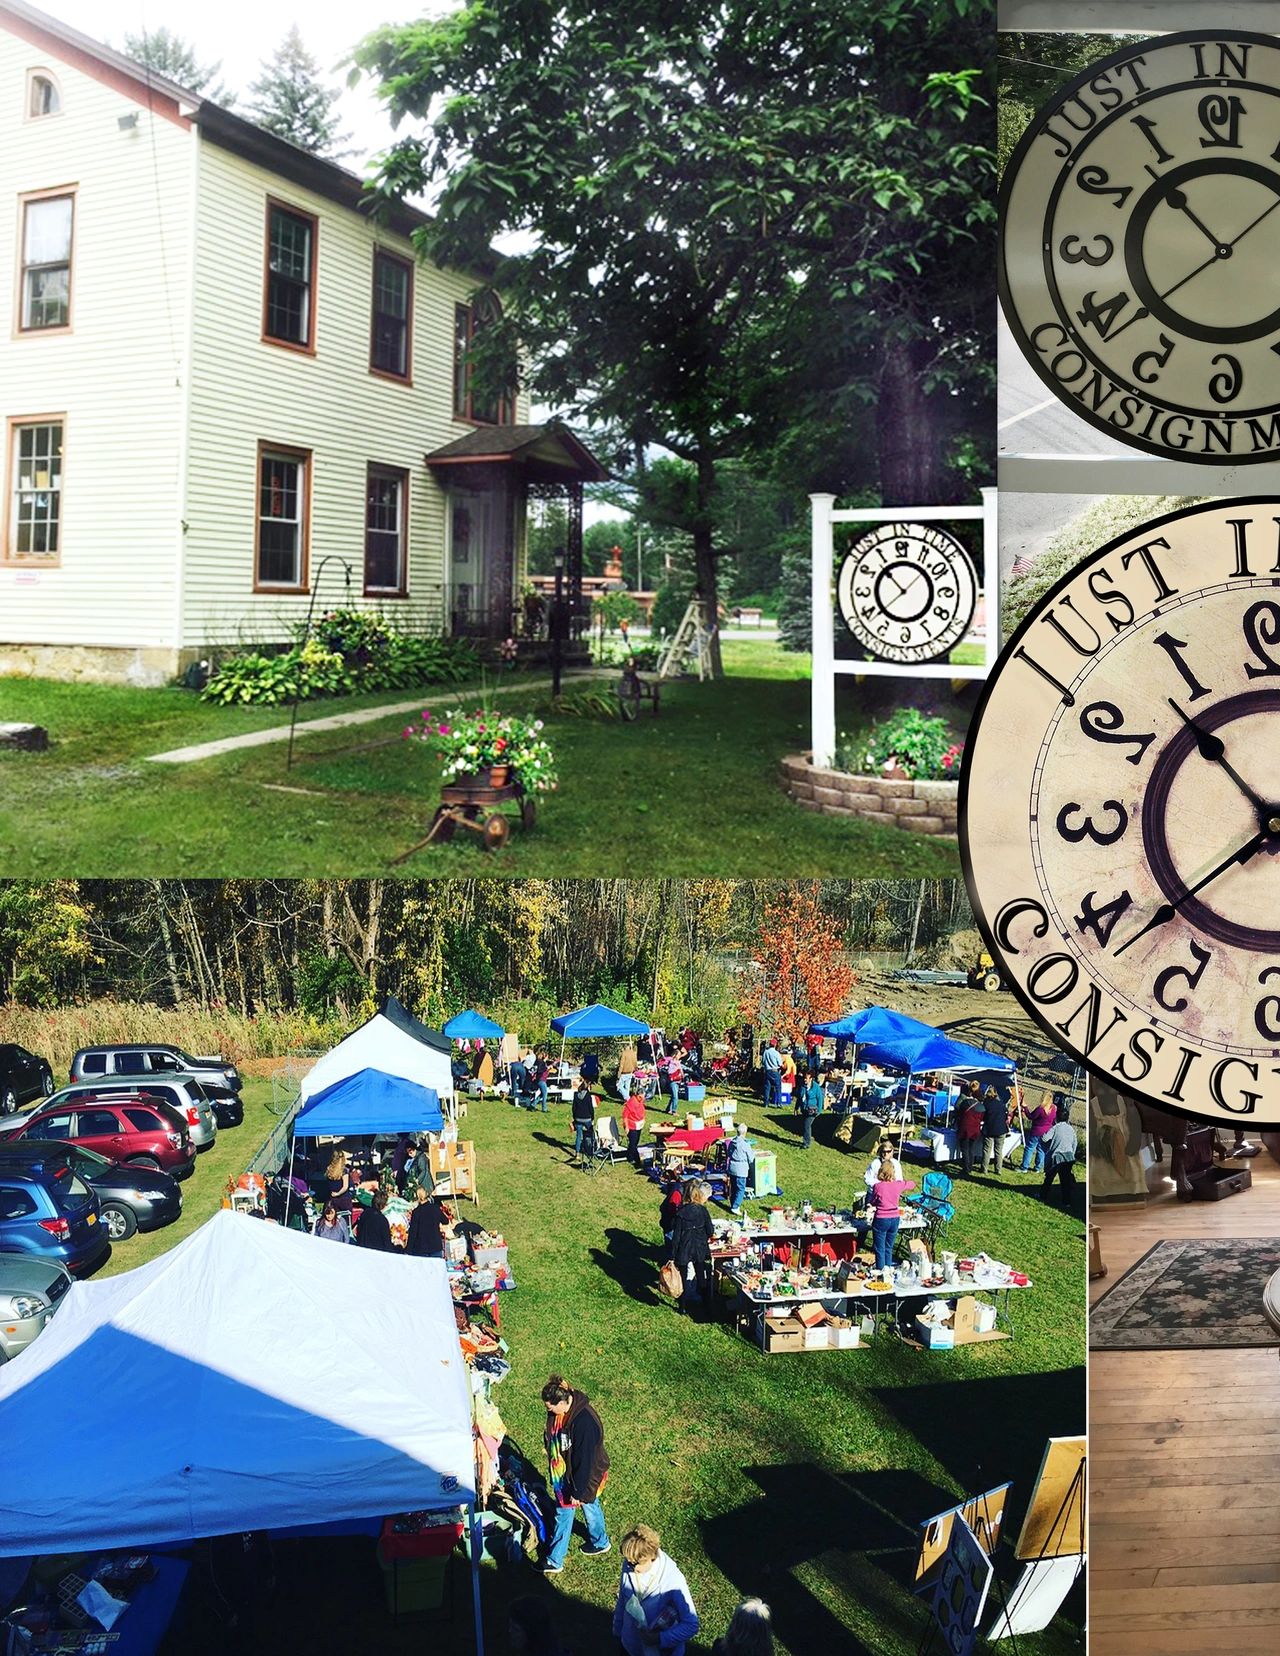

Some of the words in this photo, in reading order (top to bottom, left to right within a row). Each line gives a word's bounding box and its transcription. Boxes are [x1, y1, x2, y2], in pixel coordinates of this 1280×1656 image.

[1039, 56, 1151, 158] JUST
[1189, 43, 1252, 79] IN
[849, 530, 880, 563] JUST
[893, 523, 911, 536] IN
[923, 527, 962, 563] TIME
[847, 616, 966, 661] CONSIGNMENTS
